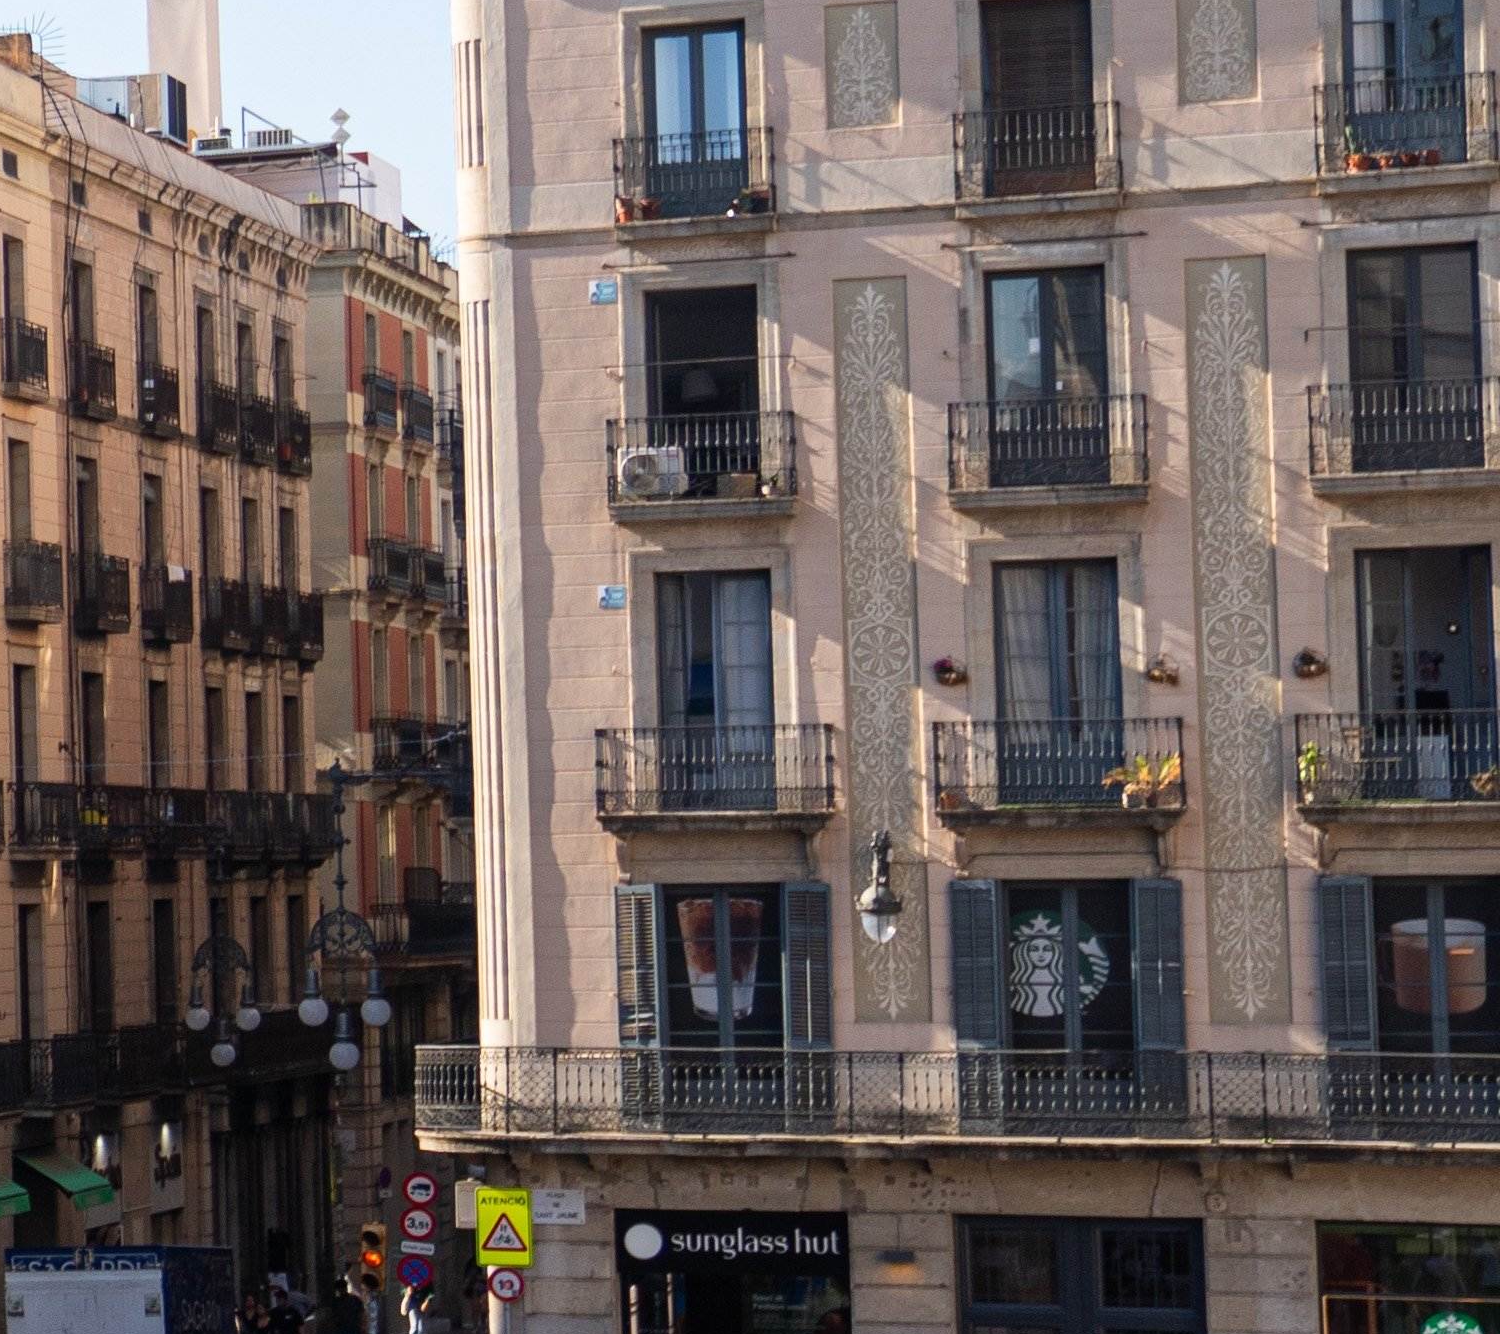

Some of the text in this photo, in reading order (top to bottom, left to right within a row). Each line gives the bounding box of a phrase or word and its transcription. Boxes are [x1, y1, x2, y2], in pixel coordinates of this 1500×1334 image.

[480, 1196, 526, 1206] ATENCIÓ
[671, 1227, 842, 1260] sunglass hut
